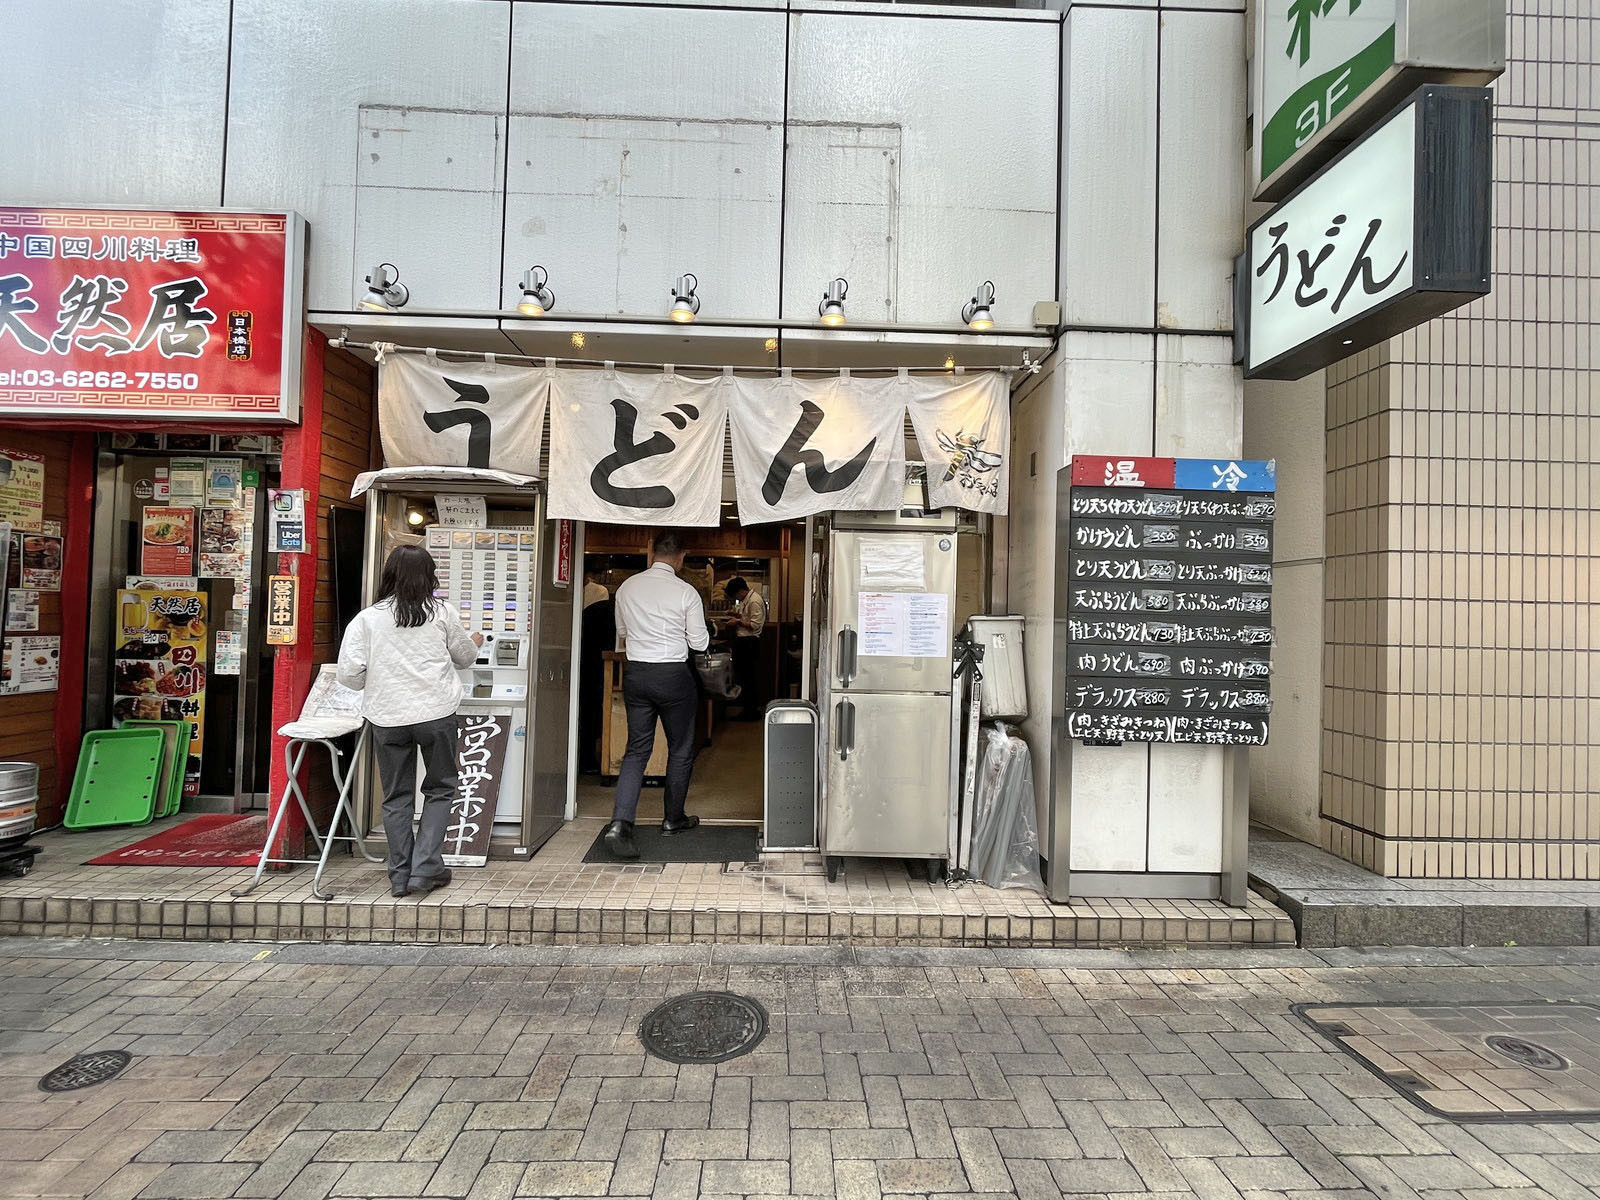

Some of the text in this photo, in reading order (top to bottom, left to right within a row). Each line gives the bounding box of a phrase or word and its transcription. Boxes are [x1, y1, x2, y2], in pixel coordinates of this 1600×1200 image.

[1294, 67, 1351, 149] 3F
[0, 233, 201, 263] 中国四川料理
[1256, 214, 1408, 314] うどん
[0, 273, 217, 359] 天然居
[423, 376, 878, 509] うどん
[1104, 460, 1145, 488] 温
[1212, 461, 1248, 493] 冷
[282, 531, 300, 539] Uber
[282, 538, 300, 546] Eats
[1076, 524, 1140, 549] かけうどん
[1186, 529, 1235, 549] ぶっかけ
[1076, 559, 1147, 580] とり天うどん
[1177, 563, 1243, 584] とり天ぶっかけ
[149, 596, 202, 616] 天然居
[273, 580, 293, 625] 営業中
[1075, 590, 1144, 611] 天ぷらうどん
[1069, 620, 1153, 643] 特上天ぷらうどん
[1076, 684, 1138, 708] デラックス
[1182, 687, 1241, 710] デラックス
[443, 714, 502, 856] 営業中
